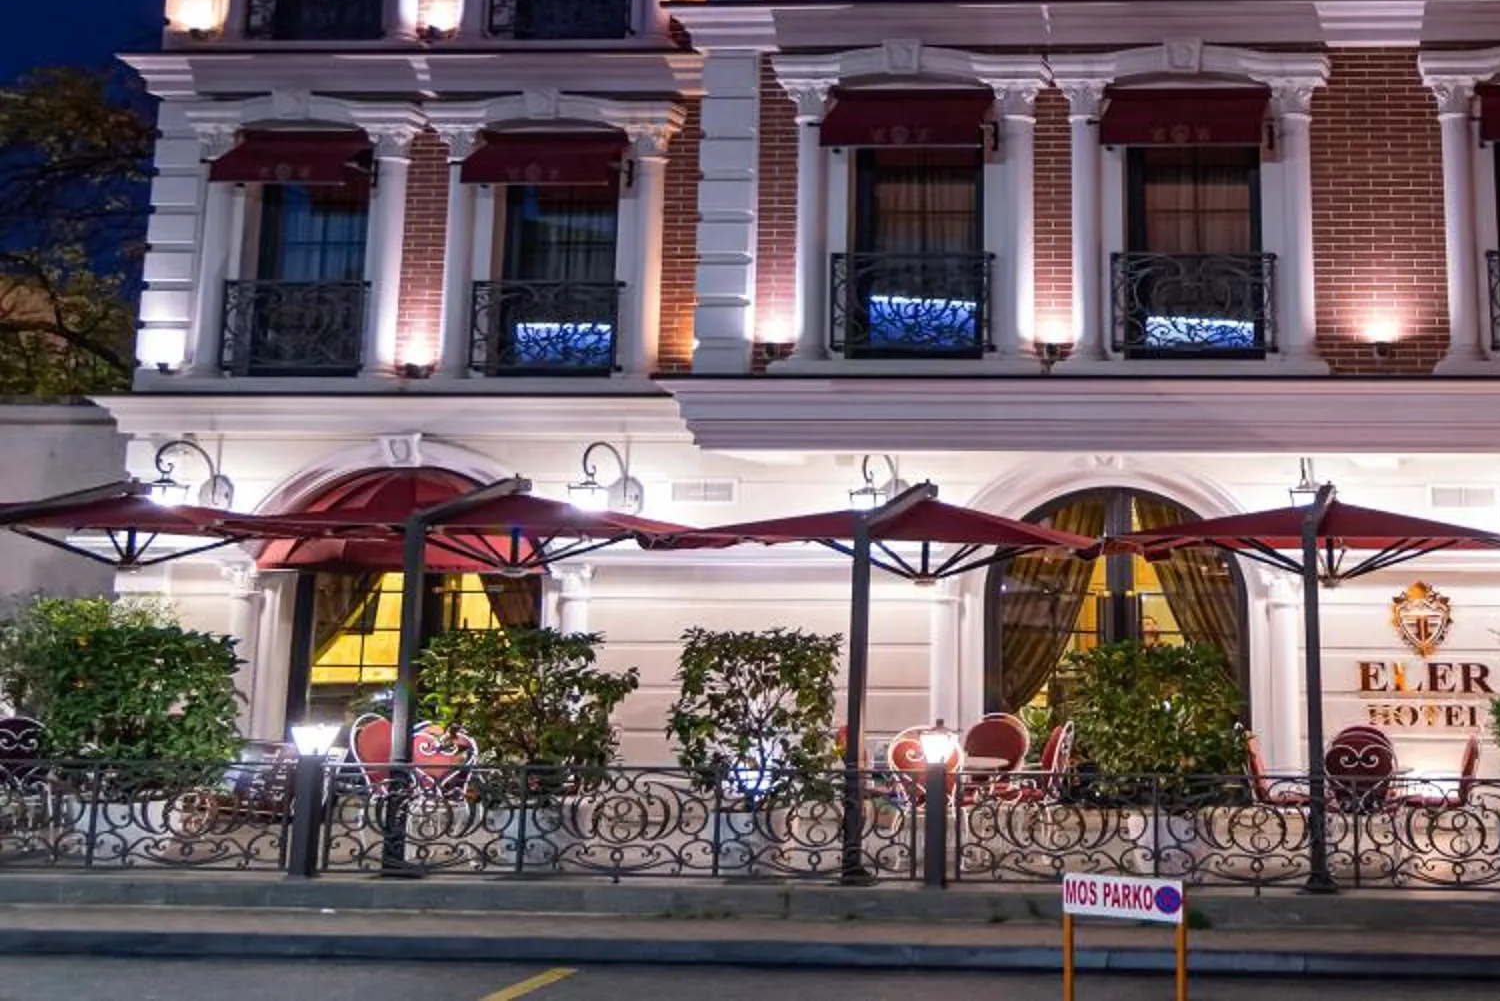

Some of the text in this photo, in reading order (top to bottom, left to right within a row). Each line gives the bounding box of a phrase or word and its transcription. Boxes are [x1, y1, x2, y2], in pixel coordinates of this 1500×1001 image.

[1358, 661, 1494, 693] ELER
[1367, 704, 1482, 727] HOTEL
[1065, 879, 1153, 911] MOS PARKO
